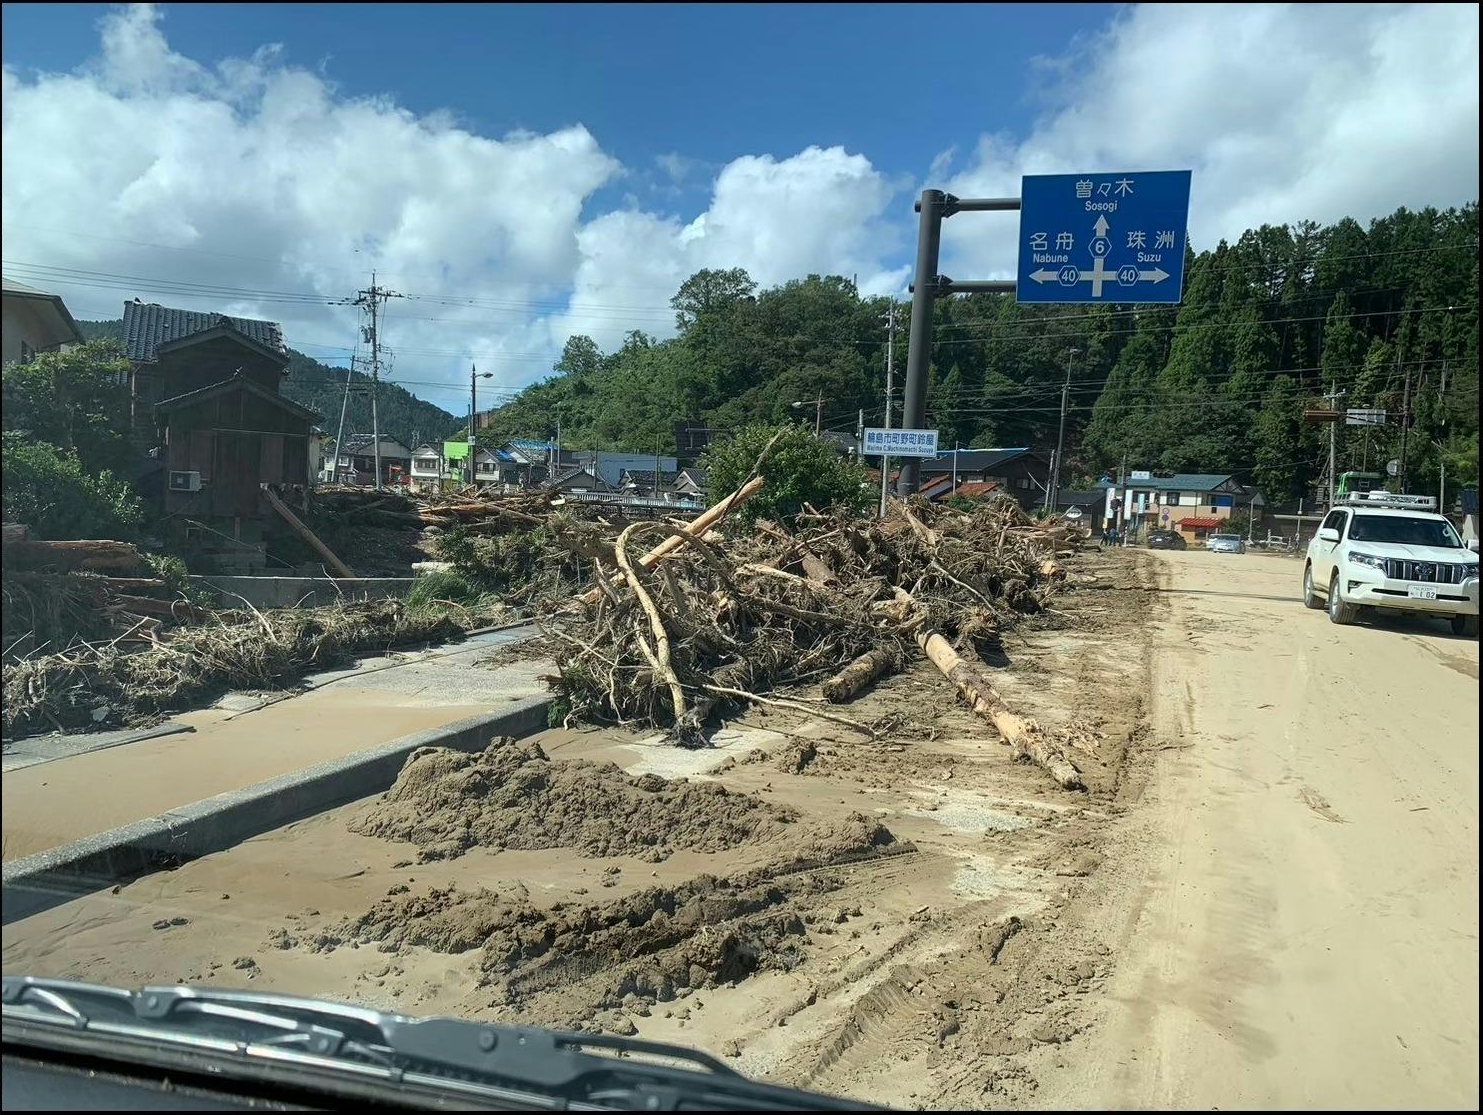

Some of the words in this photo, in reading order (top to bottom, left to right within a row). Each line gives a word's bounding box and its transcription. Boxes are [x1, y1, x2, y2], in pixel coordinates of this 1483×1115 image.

[1085, 200, 1118, 212] Sosogi
[1029, 231, 1074, 251] 名舟
[1126, 230, 1175, 250] 珠洲
[1095, 240, 1105, 254] 6
[1033, 253, 1069, 263] Nabune
[1137, 251, 1162, 262] Suzu
[1061, 269, 1076, 282] 40
[1120, 269, 1136, 282] 40
